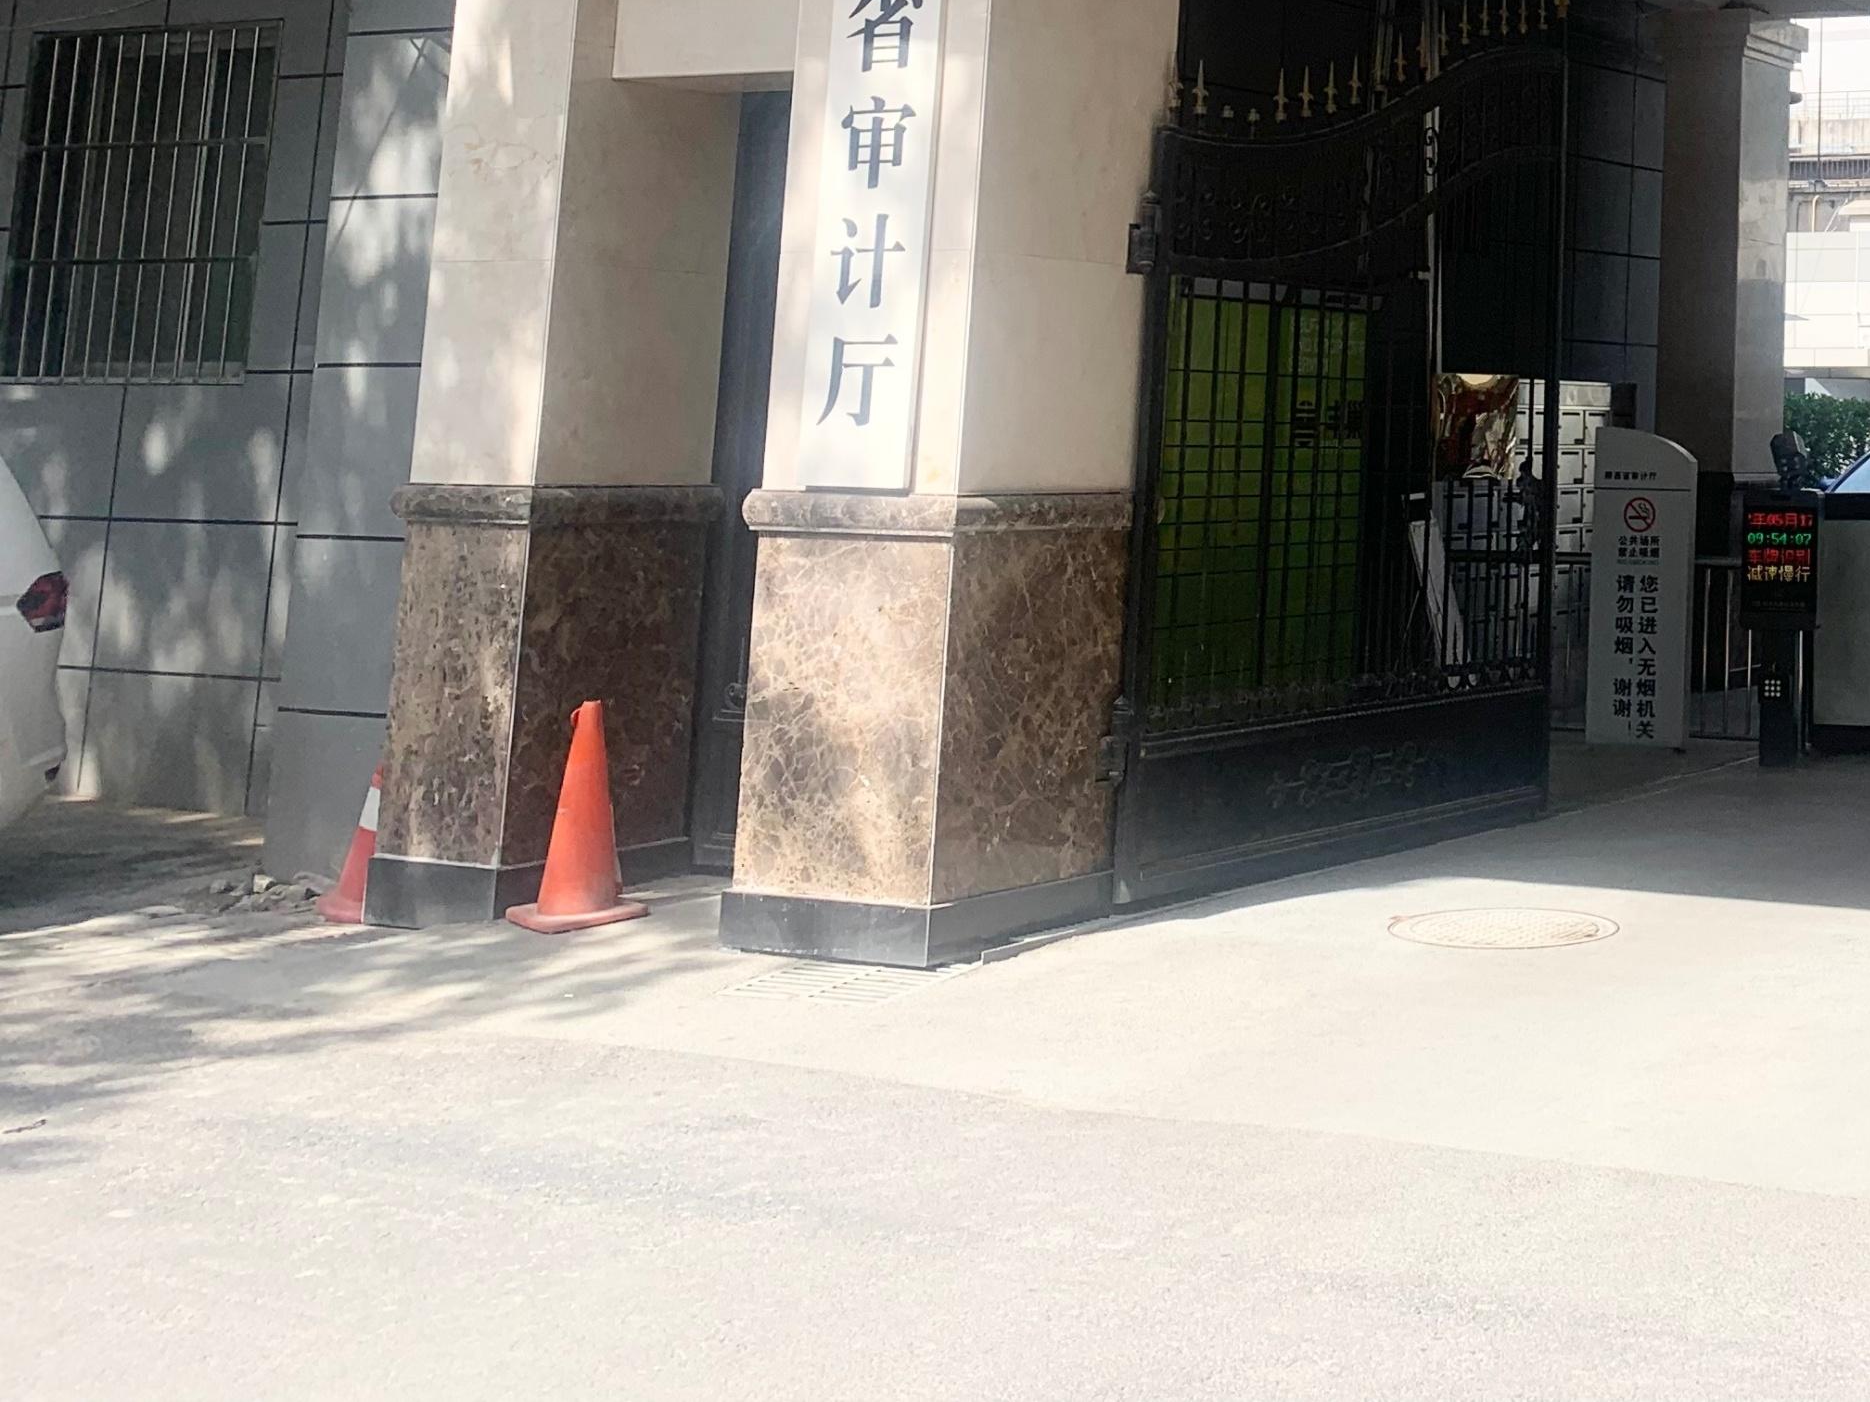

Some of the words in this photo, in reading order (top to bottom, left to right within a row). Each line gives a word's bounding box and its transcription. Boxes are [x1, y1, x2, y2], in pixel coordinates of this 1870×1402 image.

[1747, 531, 1812, 545] 09:54:07
[1746, 564, 1811, 583] 减速慢行
[1635, 574, 1659, 740] 您已进入无烟机关
